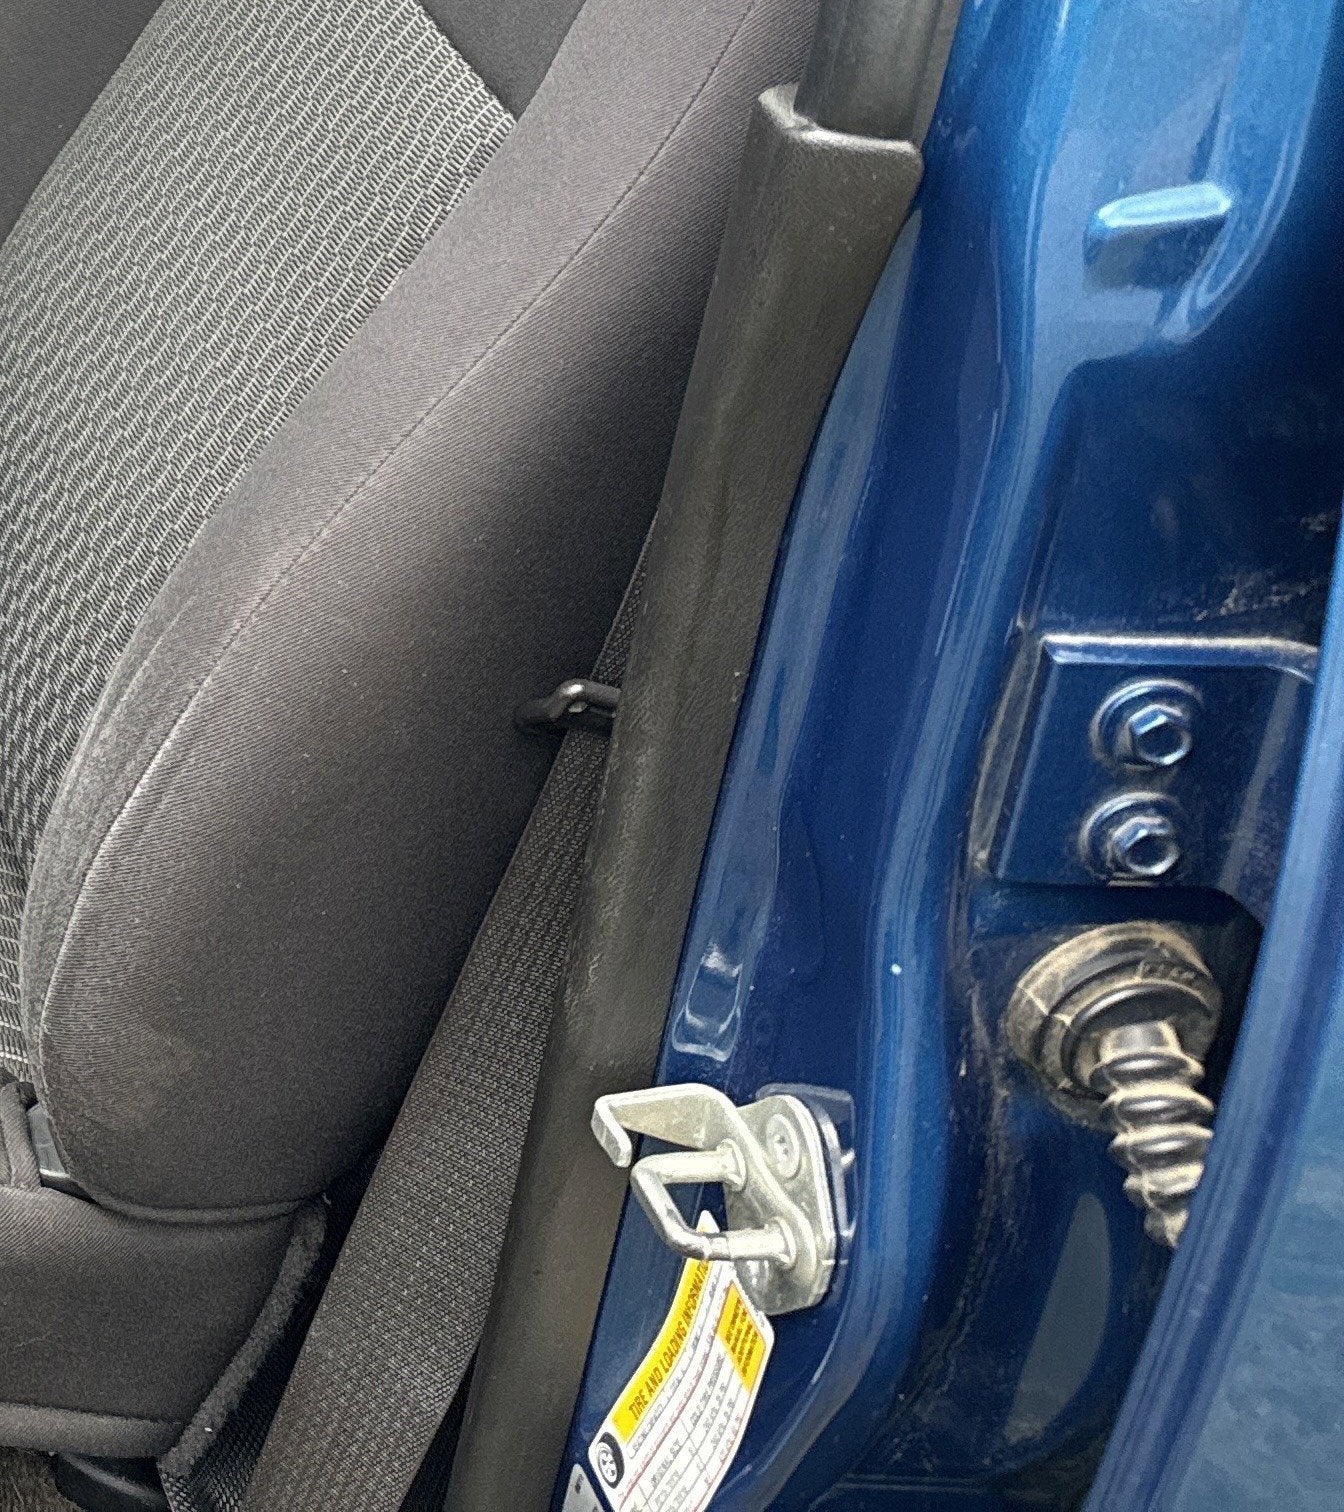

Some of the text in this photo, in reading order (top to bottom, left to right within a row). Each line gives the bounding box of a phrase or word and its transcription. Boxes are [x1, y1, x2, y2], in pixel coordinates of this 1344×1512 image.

[628, 1388, 649, 1422] TIRE
[644, 1366, 664, 1398] AND
[659, 1320, 688, 1374] LOADING
